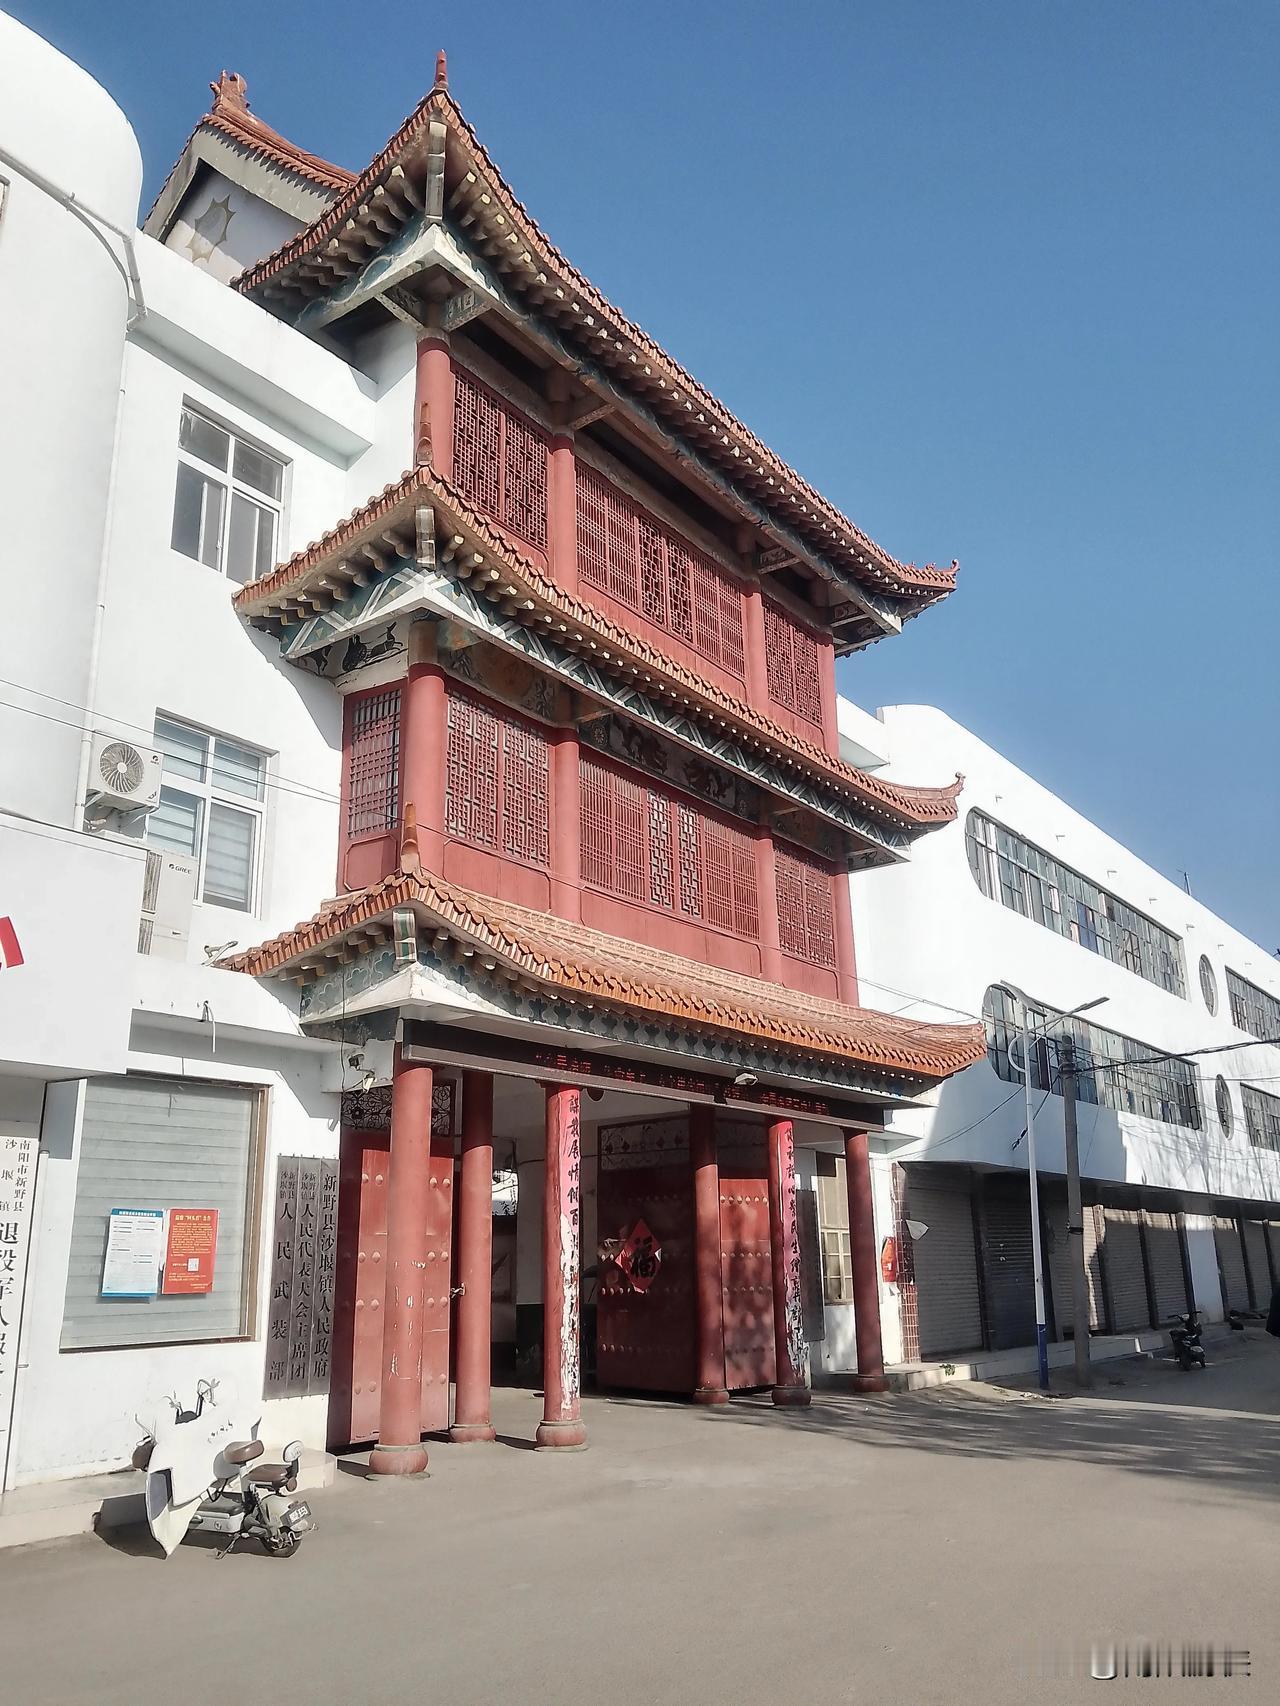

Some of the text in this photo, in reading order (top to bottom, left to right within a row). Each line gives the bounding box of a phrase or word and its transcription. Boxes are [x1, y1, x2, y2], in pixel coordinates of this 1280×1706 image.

[13, 1140, 31, 1212] 南阳市新野县
[269, 1202, 294, 1381] 人民武装部
[291, 1203, 314, 1381] 人民代表大会主席团
[313, 1173, 337, 1378] 新野县沙堰镇人民政府
